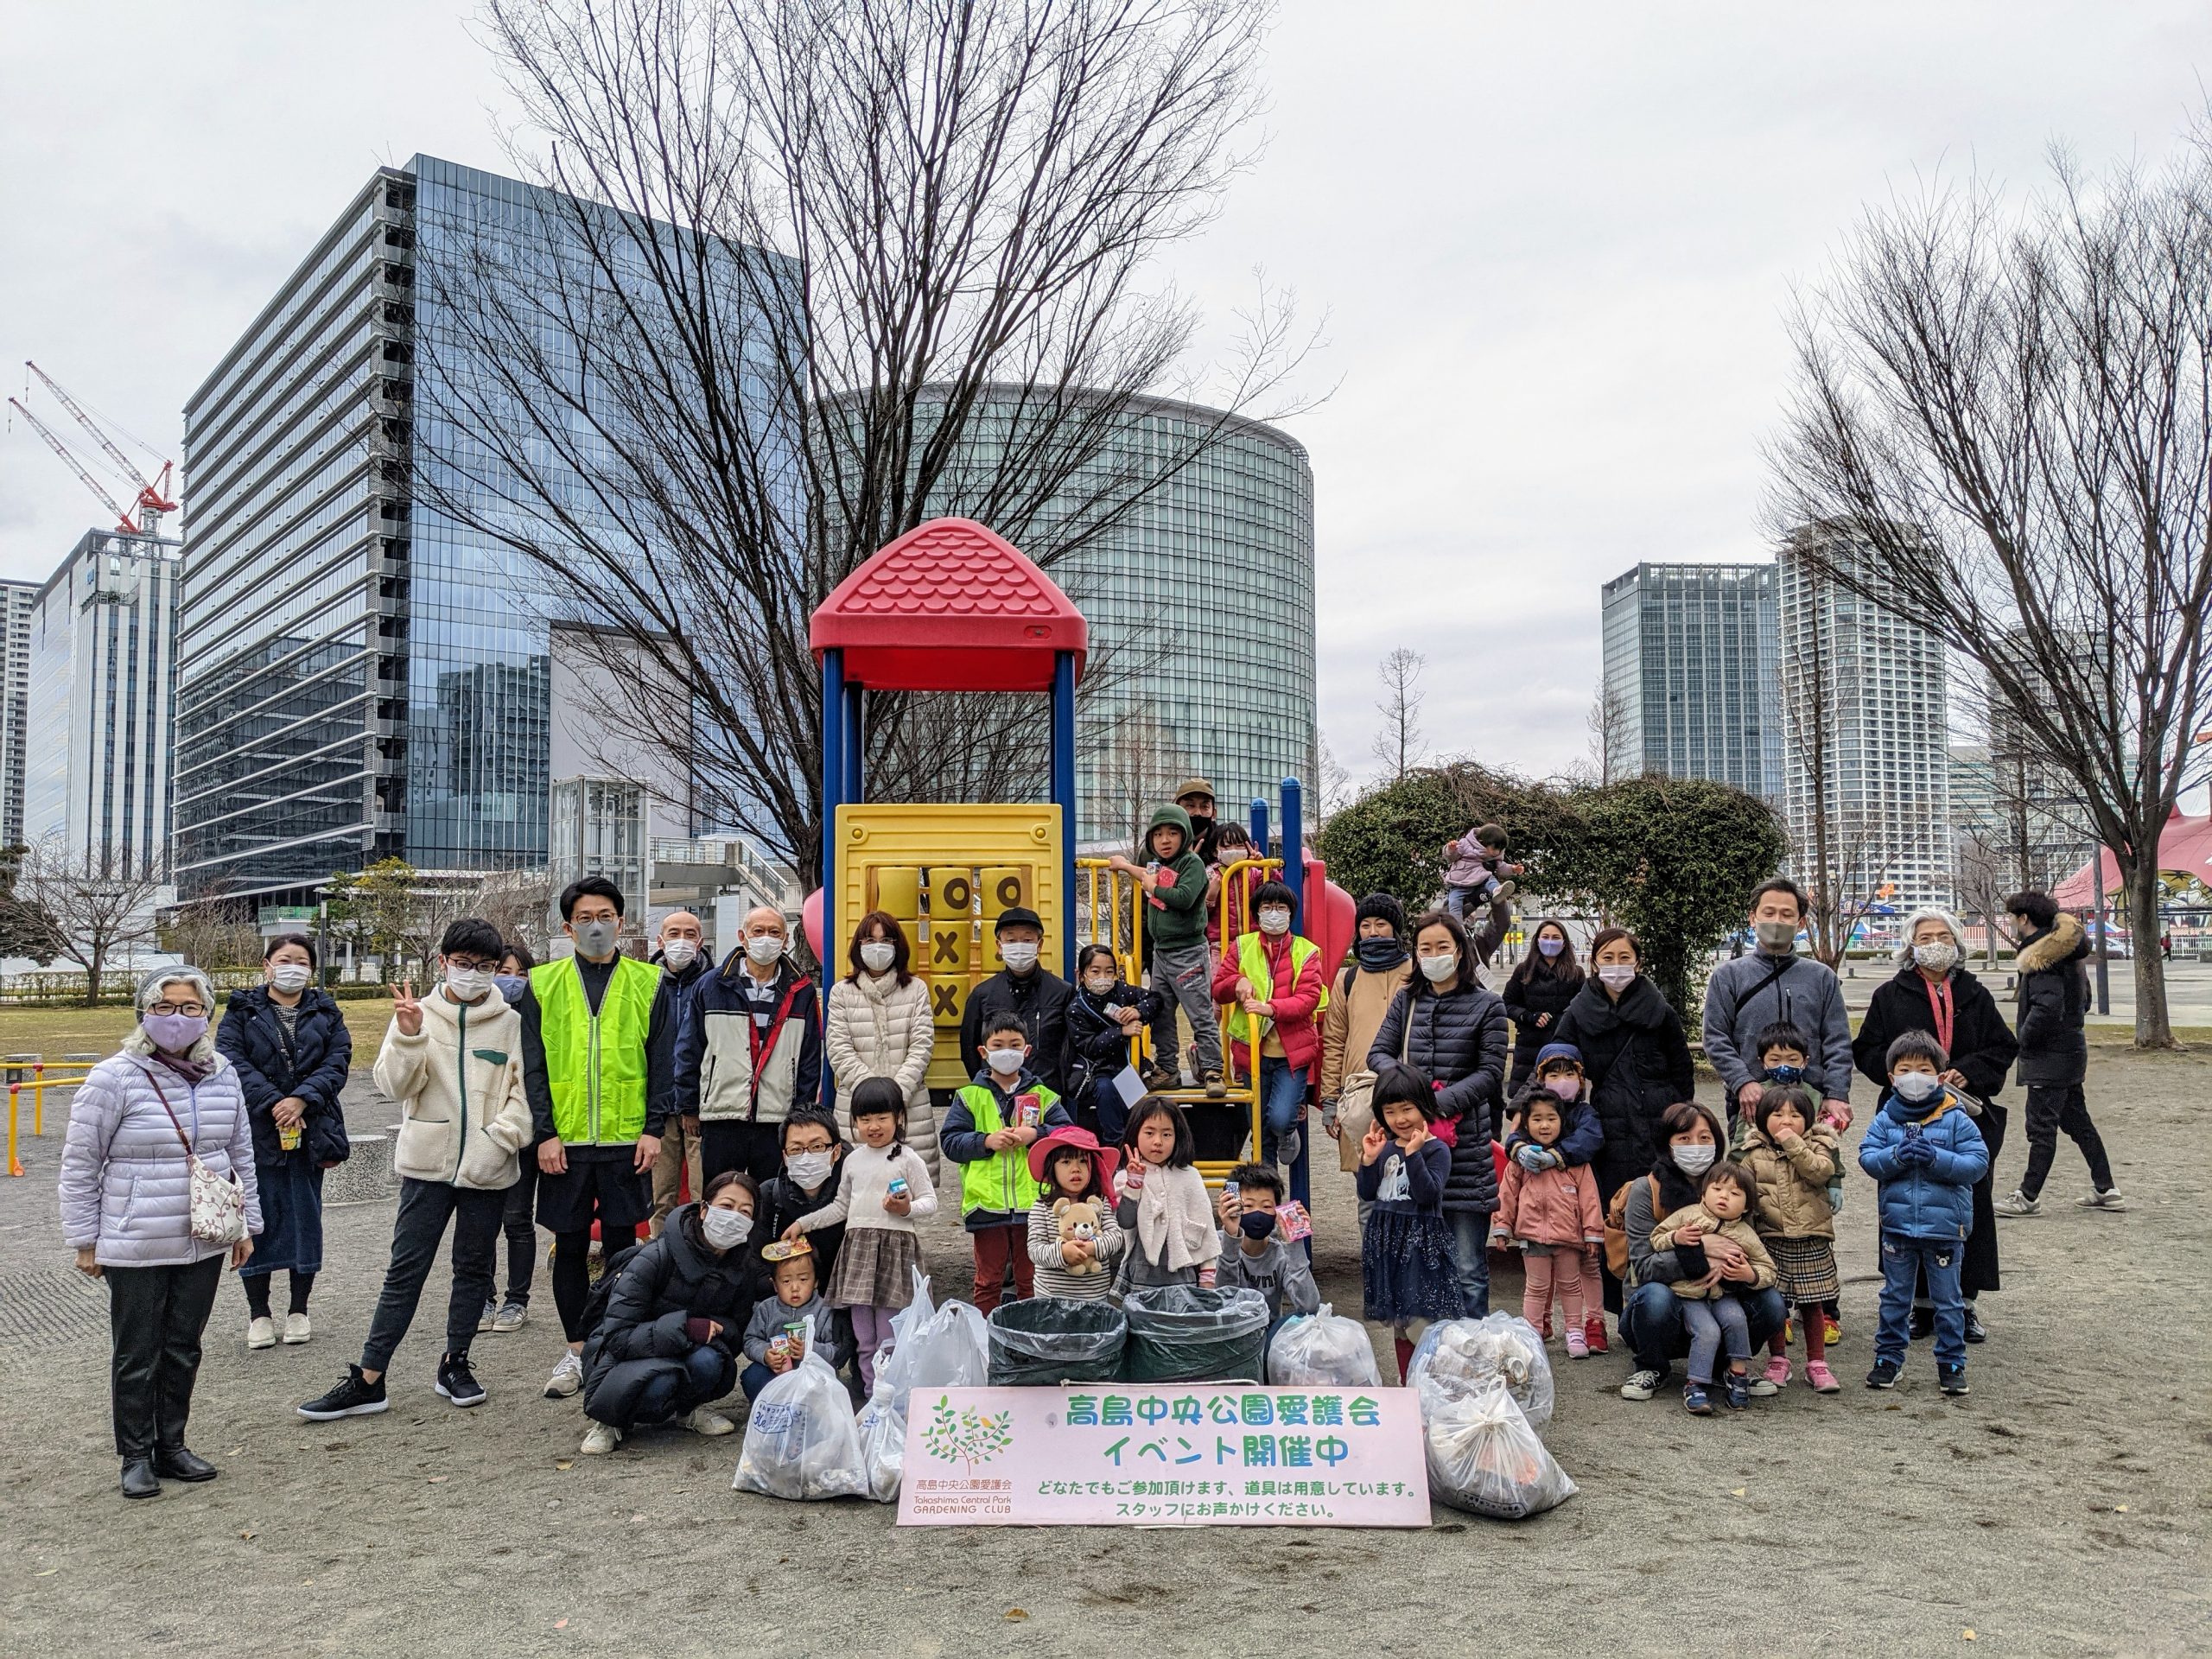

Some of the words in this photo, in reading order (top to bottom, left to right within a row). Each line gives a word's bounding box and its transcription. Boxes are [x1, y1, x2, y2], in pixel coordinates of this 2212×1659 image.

[1066, 1394, 1381, 1427] 高島中央公園愛護会
[1103, 1434, 1349, 1467] イベント開催中
[916, 1479, 1013, 1491] 高島中央公園愛護会
[914, 1496, 959, 1504] Takashima
[961, 1496, 991, 1504] Central
[992, 1496, 1012, 1504] Park
[913, 1505, 977, 1514] GARDENING
[984, 1505, 1011, 1514] CLUB
[1116, 1502, 1335, 1518] スタッフにお声かけください。
